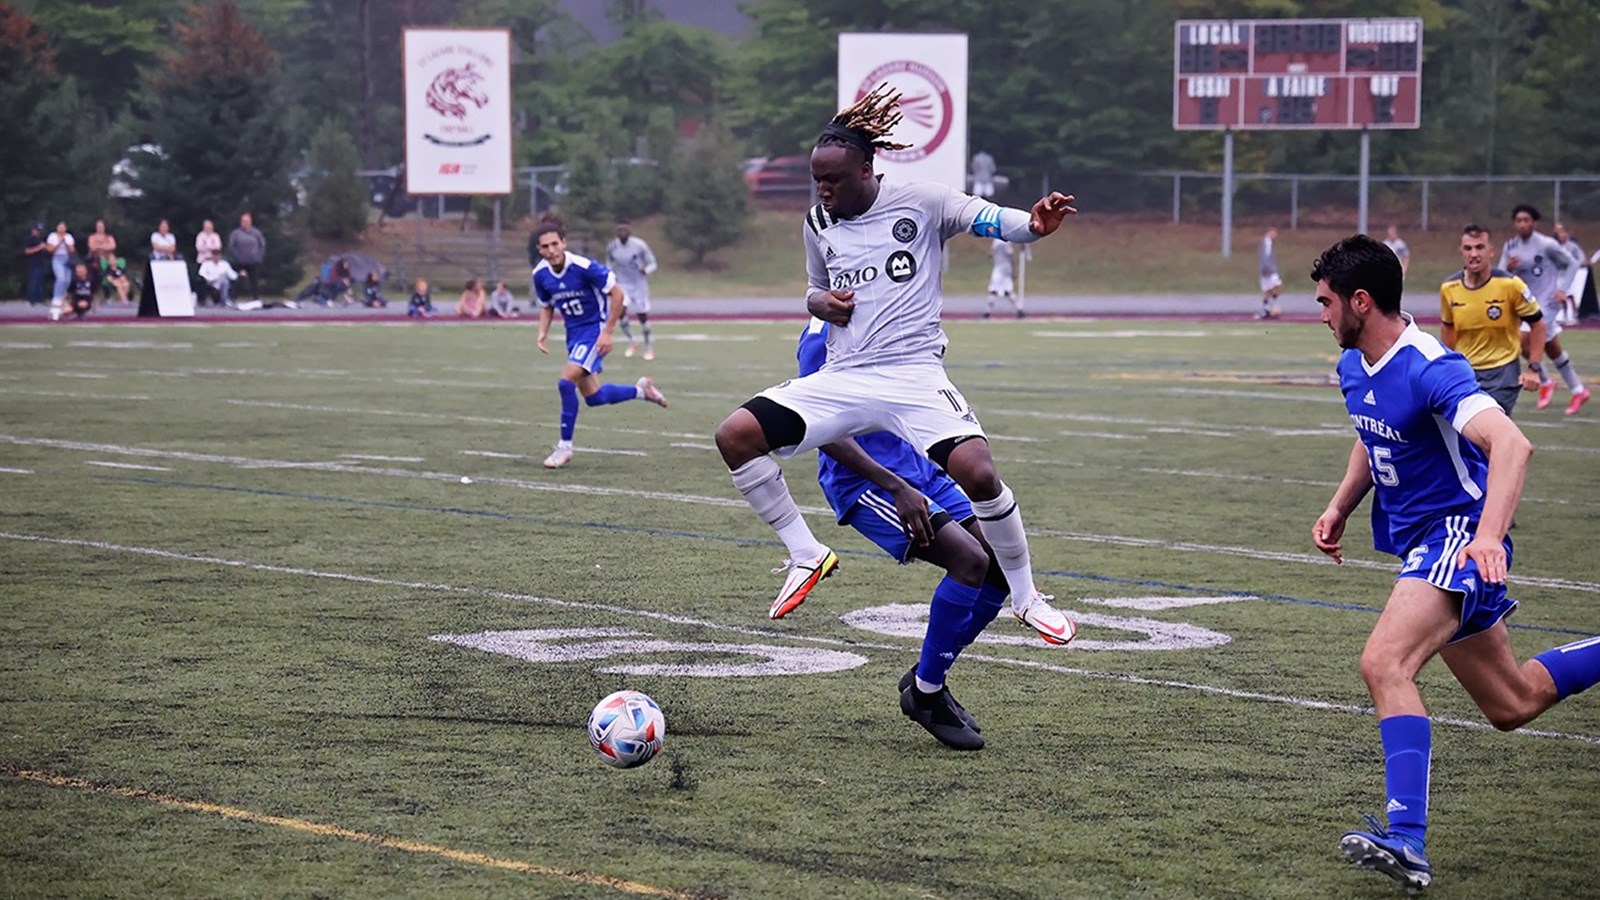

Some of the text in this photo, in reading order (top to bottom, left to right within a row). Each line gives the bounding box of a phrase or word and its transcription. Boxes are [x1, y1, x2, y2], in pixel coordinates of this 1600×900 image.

[1190, 22, 1240, 45] LOCAL
[1188, 75, 1230, 97] ESSAI
[1283, 75, 1325, 97] FAIRE
[833, 266, 878, 290] BMO
[1350, 413, 1409, 444] ONTRÉAL
